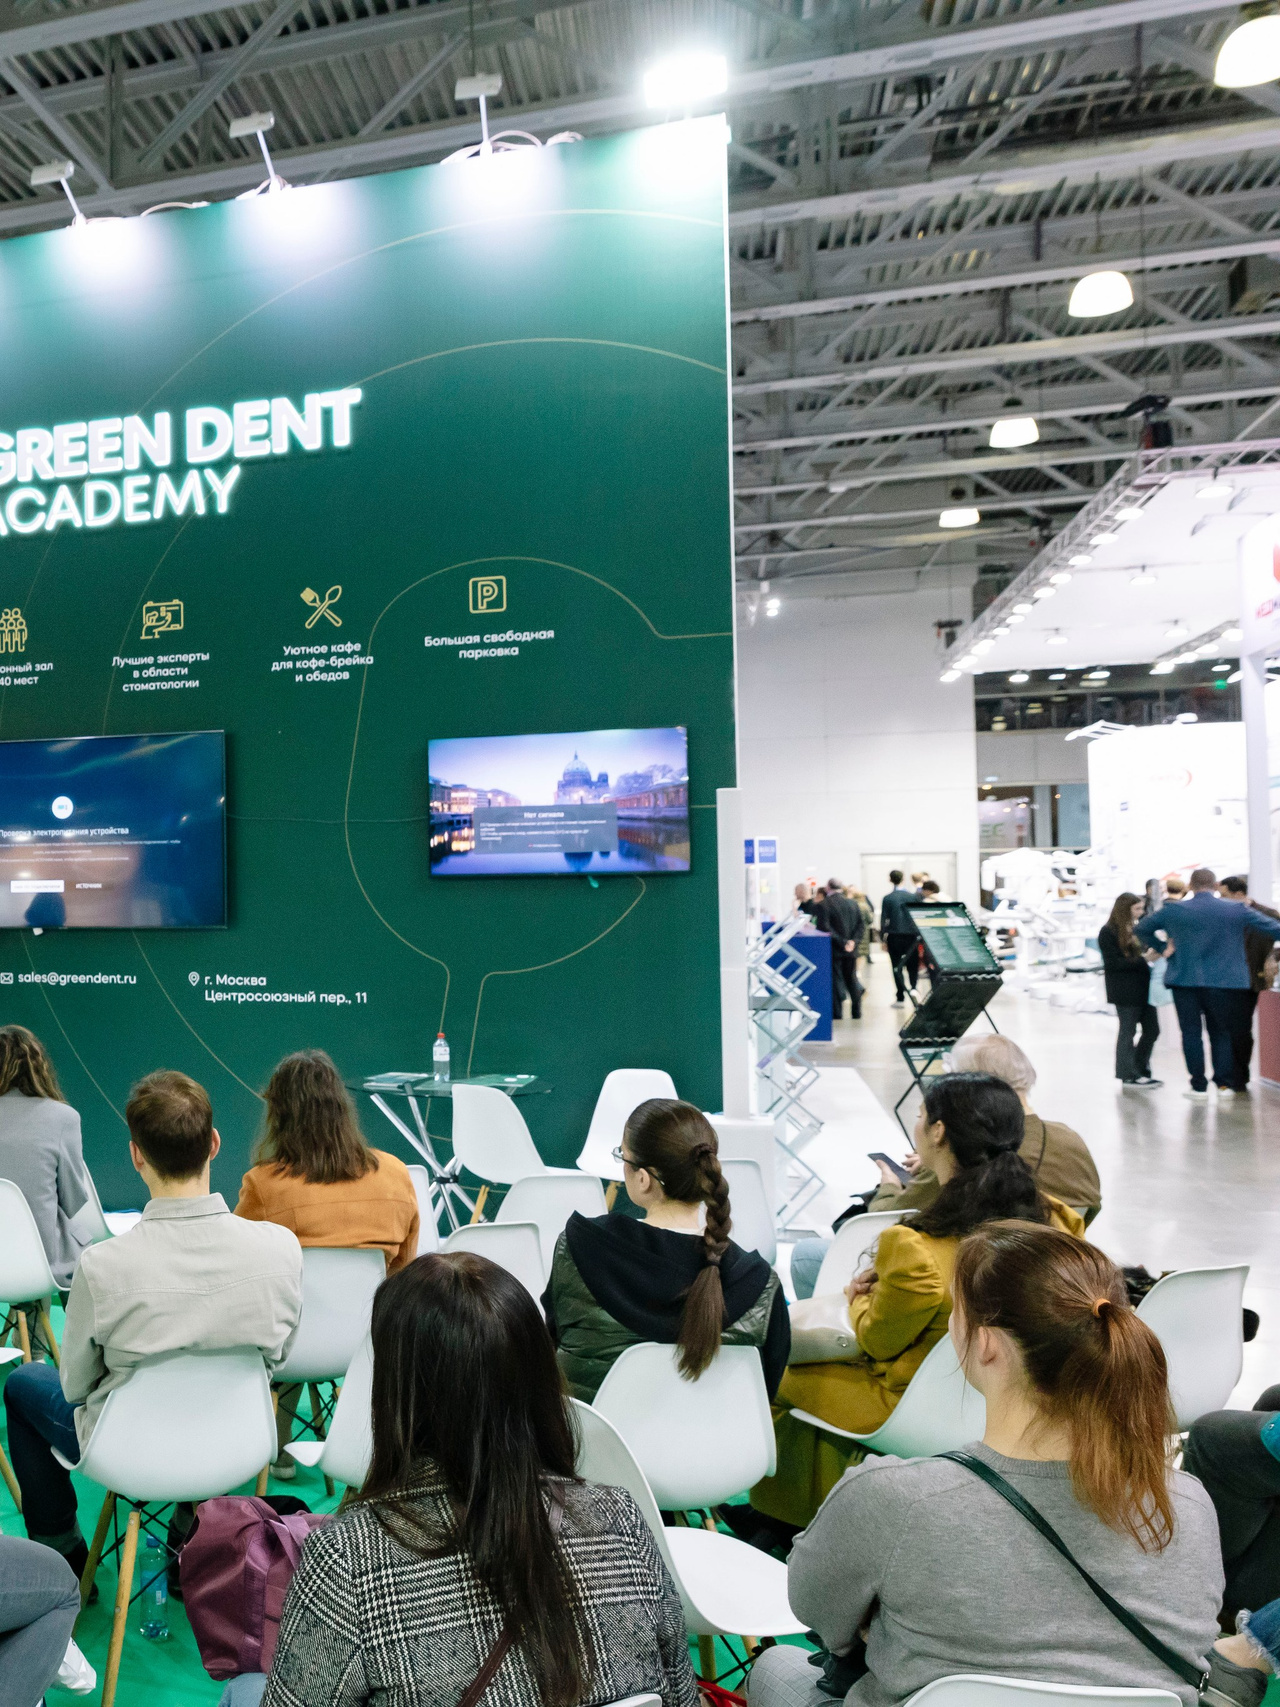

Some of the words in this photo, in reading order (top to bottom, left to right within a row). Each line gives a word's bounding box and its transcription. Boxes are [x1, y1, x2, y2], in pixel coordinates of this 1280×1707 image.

[184, 386, 363, 462] DENT
[425, 634, 480, 647] Большая
[483, 629, 555, 644] свободная
[283, 644, 328, 656] Уютное
[331, 641, 362, 654] кафе
[458, 646, 520, 659] парковка
[35, 660, 53, 673] зал
[111, 655, 154, 668] Лучшие
[157, 652, 210, 666] эксперты
[270, 660, 293, 672] для
[296, 653, 374, 670] кофе-брейка
[131, 671, 141, 679] в
[143, 666, 188, 678] области
[294, 674, 304, 684] и
[306, 670, 350, 682] обедов
[14, 674, 39, 687] мест
[121, 678, 199, 692] стоматологии
[18, 971, 137, 986] sales@greendent.ru
[204, 974, 213, 986] г.
[216, 974, 267, 986] Москва
[205, 990, 316, 1004] Центросоюзный
[319, 991, 352, 1006] пер.,
[354, 992, 368, 1004] 11
